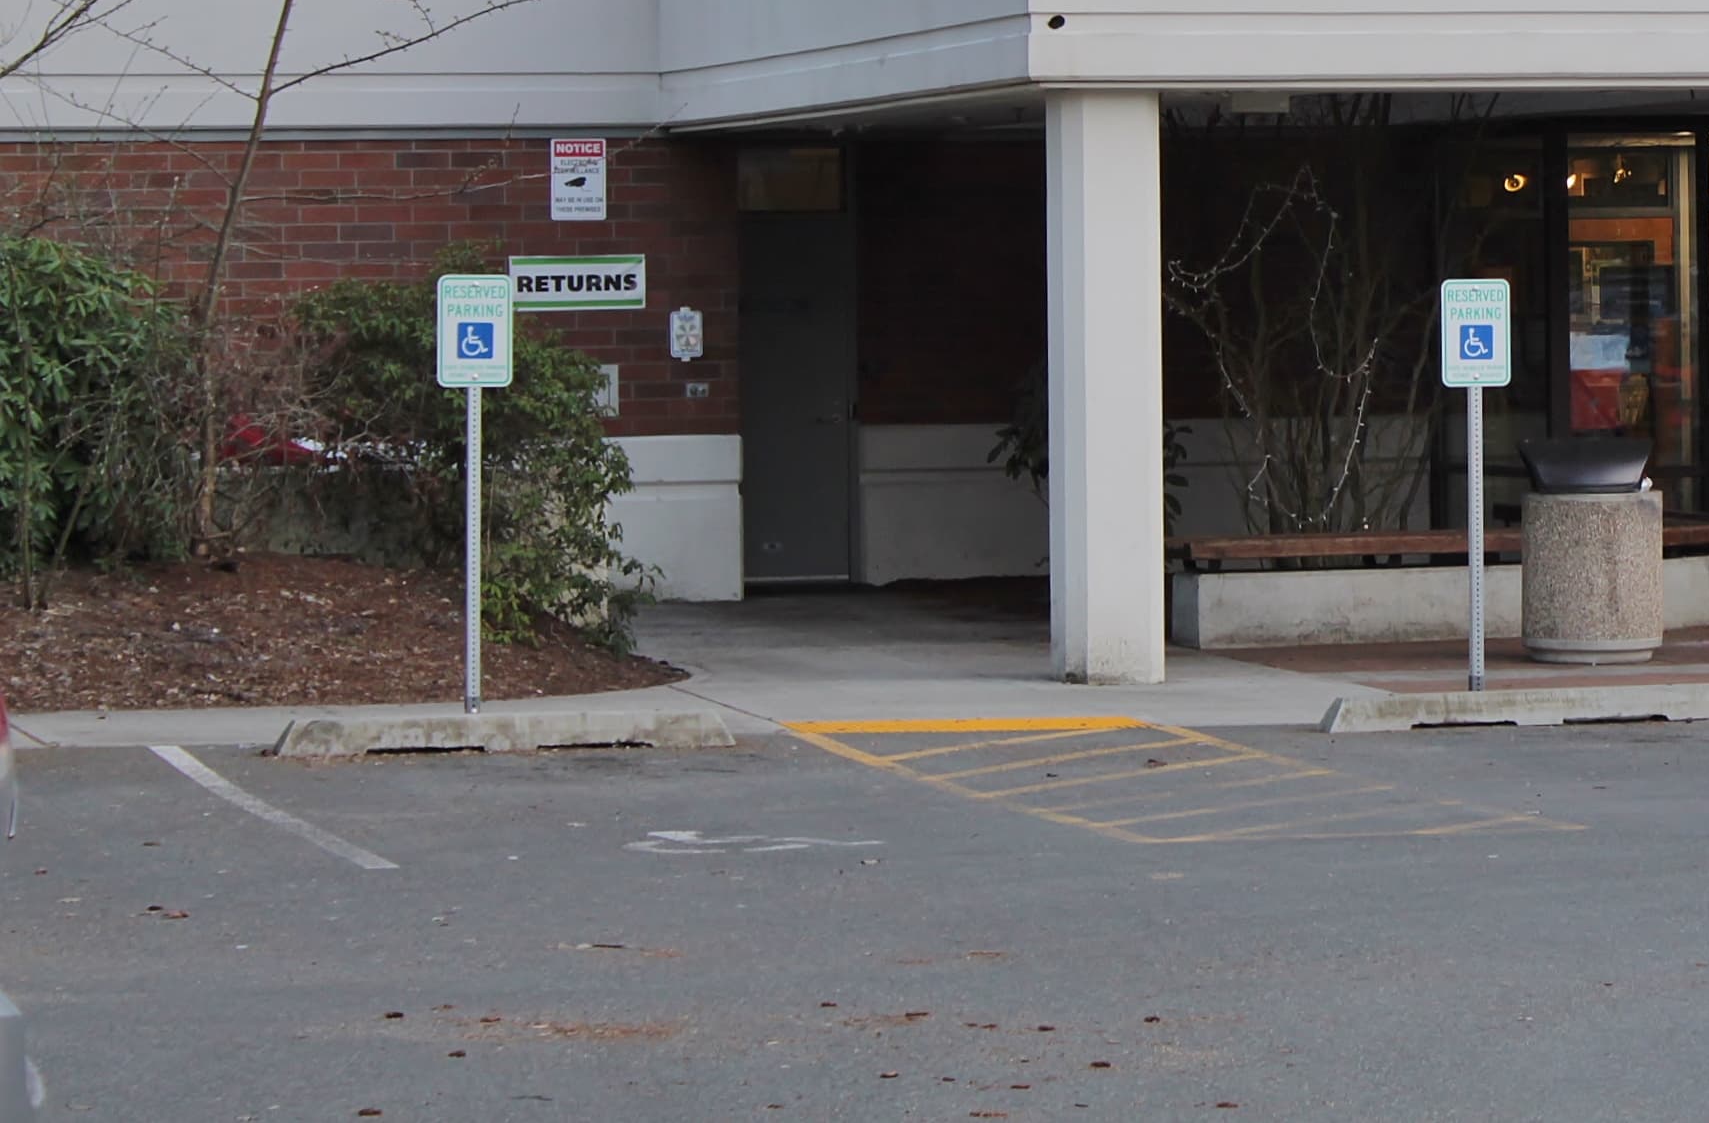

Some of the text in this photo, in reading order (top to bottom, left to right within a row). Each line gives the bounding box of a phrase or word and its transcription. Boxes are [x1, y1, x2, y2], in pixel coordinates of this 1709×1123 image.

[556, 143, 601, 153] NOTICE
[516, 273, 638, 293] RETURNS
[444, 285, 506, 299] RESERVED
[1447, 289, 1504, 302] RESERVED
[447, 304, 504, 318] PARKING
[1450, 307, 1502, 320] PARKING
